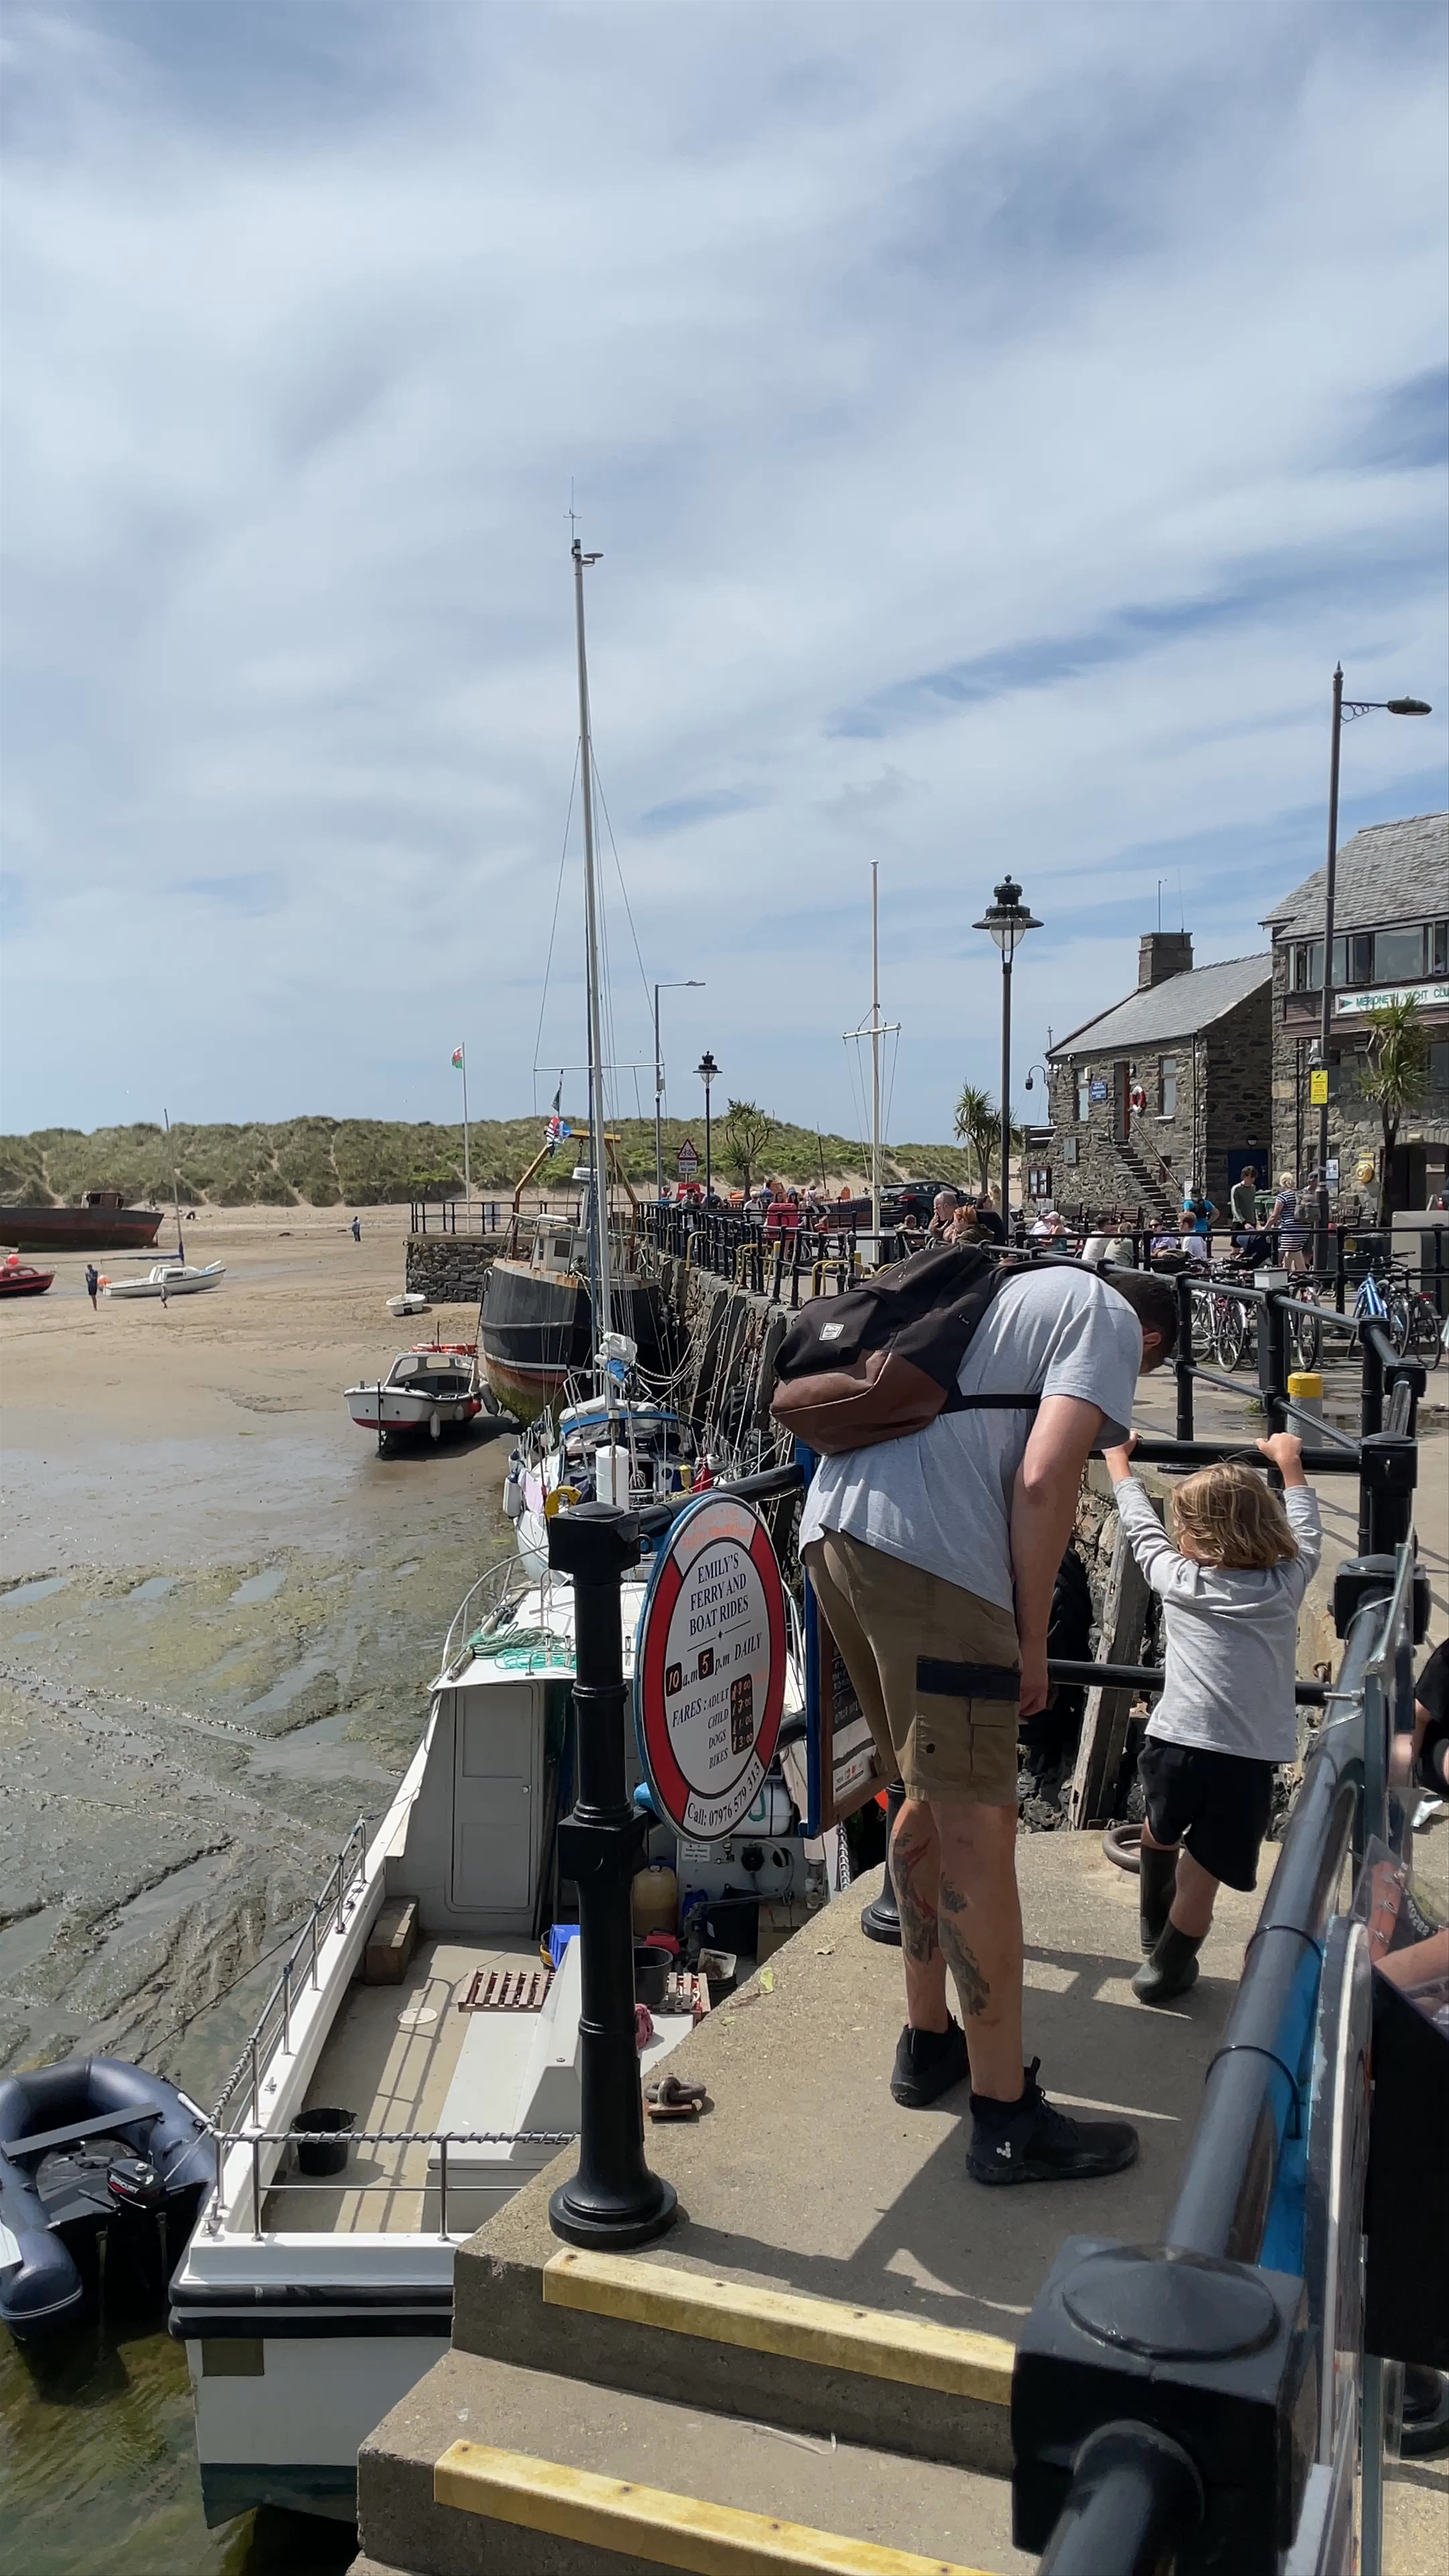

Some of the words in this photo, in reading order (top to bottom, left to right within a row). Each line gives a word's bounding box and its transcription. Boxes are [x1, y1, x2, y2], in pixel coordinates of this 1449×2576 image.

[698, 1552, 739, 1584] EMILY'S
[690, 1581, 724, 1612] FERRY
[726, 1573, 746, 1596] AND
[689, 1608, 717, 1637] BOAT
[720, 1594, 749, 1622] RIDES
[668, 1670, 679, 1692] 10
[702, 1654, 710, 1675] 5
[734, 1632, 762, 1661] DAILY
[708, 1688, 729, 1710] ADULT
[708, 1709, 729, 1729] CHILD
[709, 1729, 726, 1749] DOGS
[709, 1747, 728, 1769] BIKES
[688, 1802, 707, 1826] Call:
[709, 1801, 732, 1827] 07976
[734, 1787, 747, 1812] 579
[747, 1761, 760, 1792] 313
